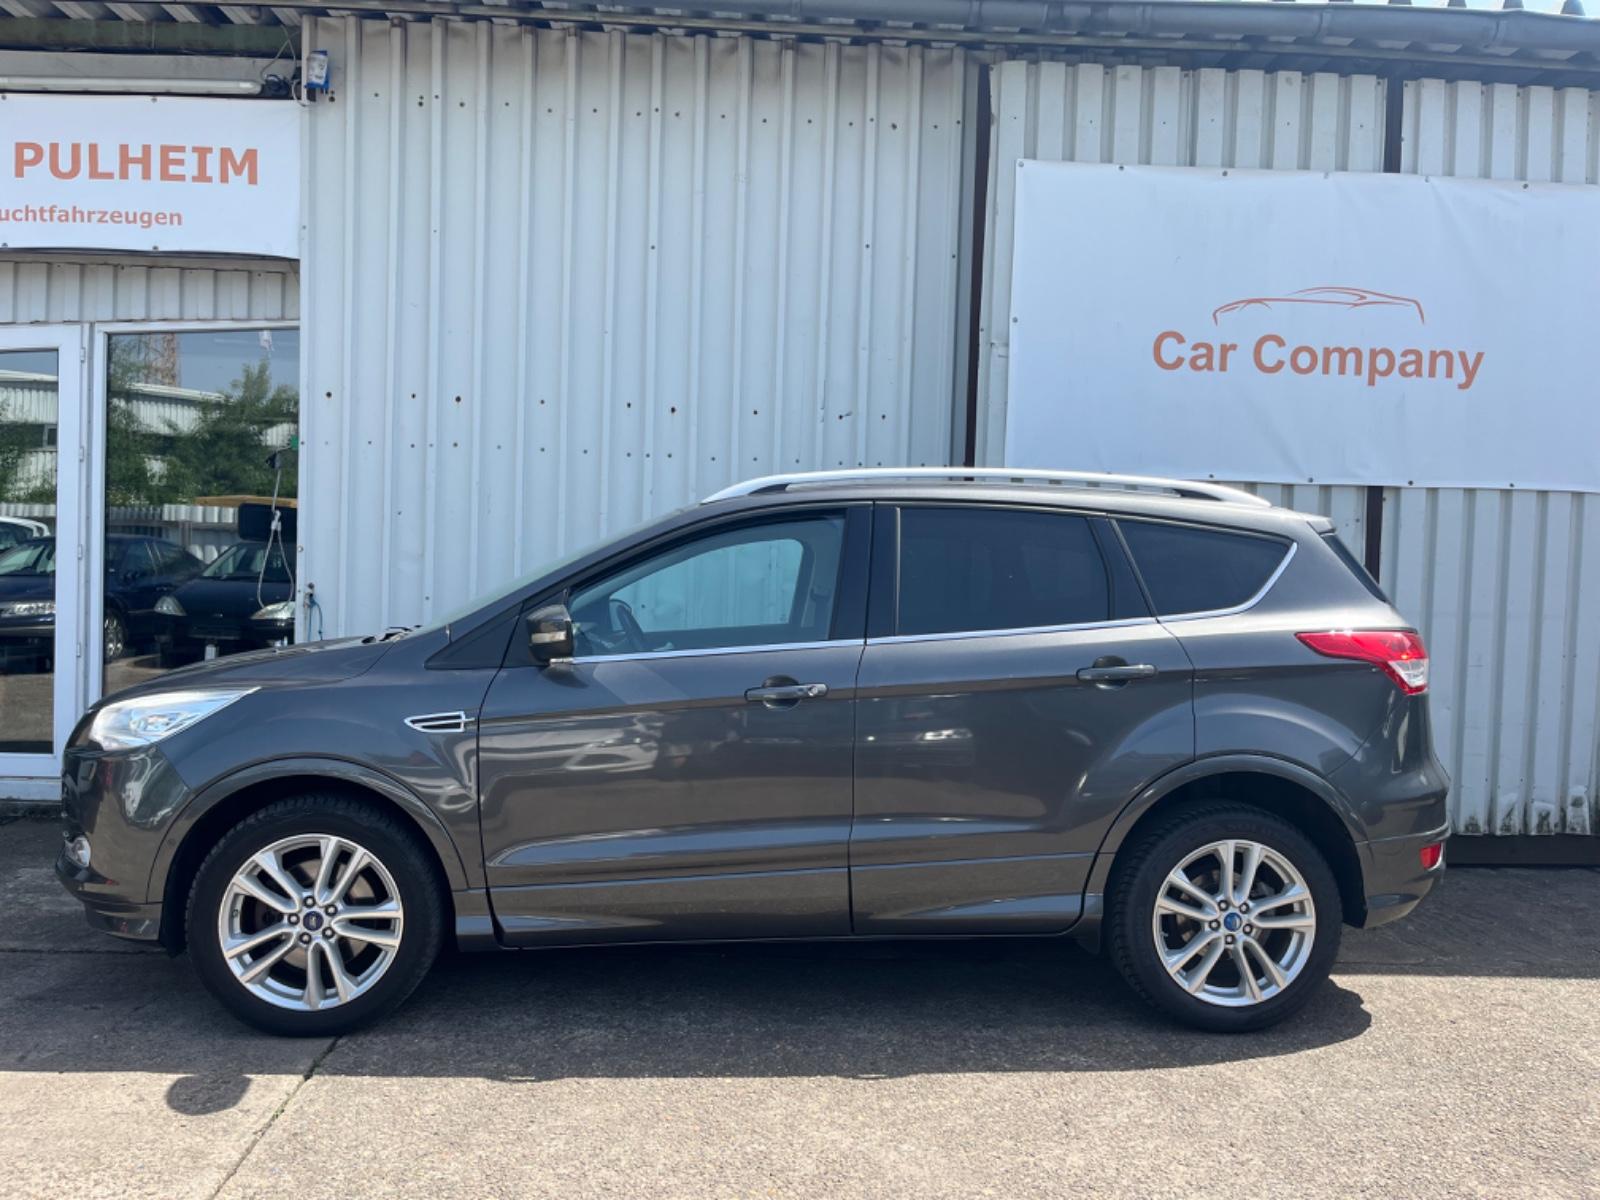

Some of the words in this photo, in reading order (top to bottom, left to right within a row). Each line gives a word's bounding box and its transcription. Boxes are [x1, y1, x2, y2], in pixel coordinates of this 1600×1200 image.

[14, 141, 259, 186] PULHEIM
[0, 204, 183, 229] uchtfahrzeugen
[1152, 330, 1238, 373] Car
[1253, 334, 1485, 390] Company
